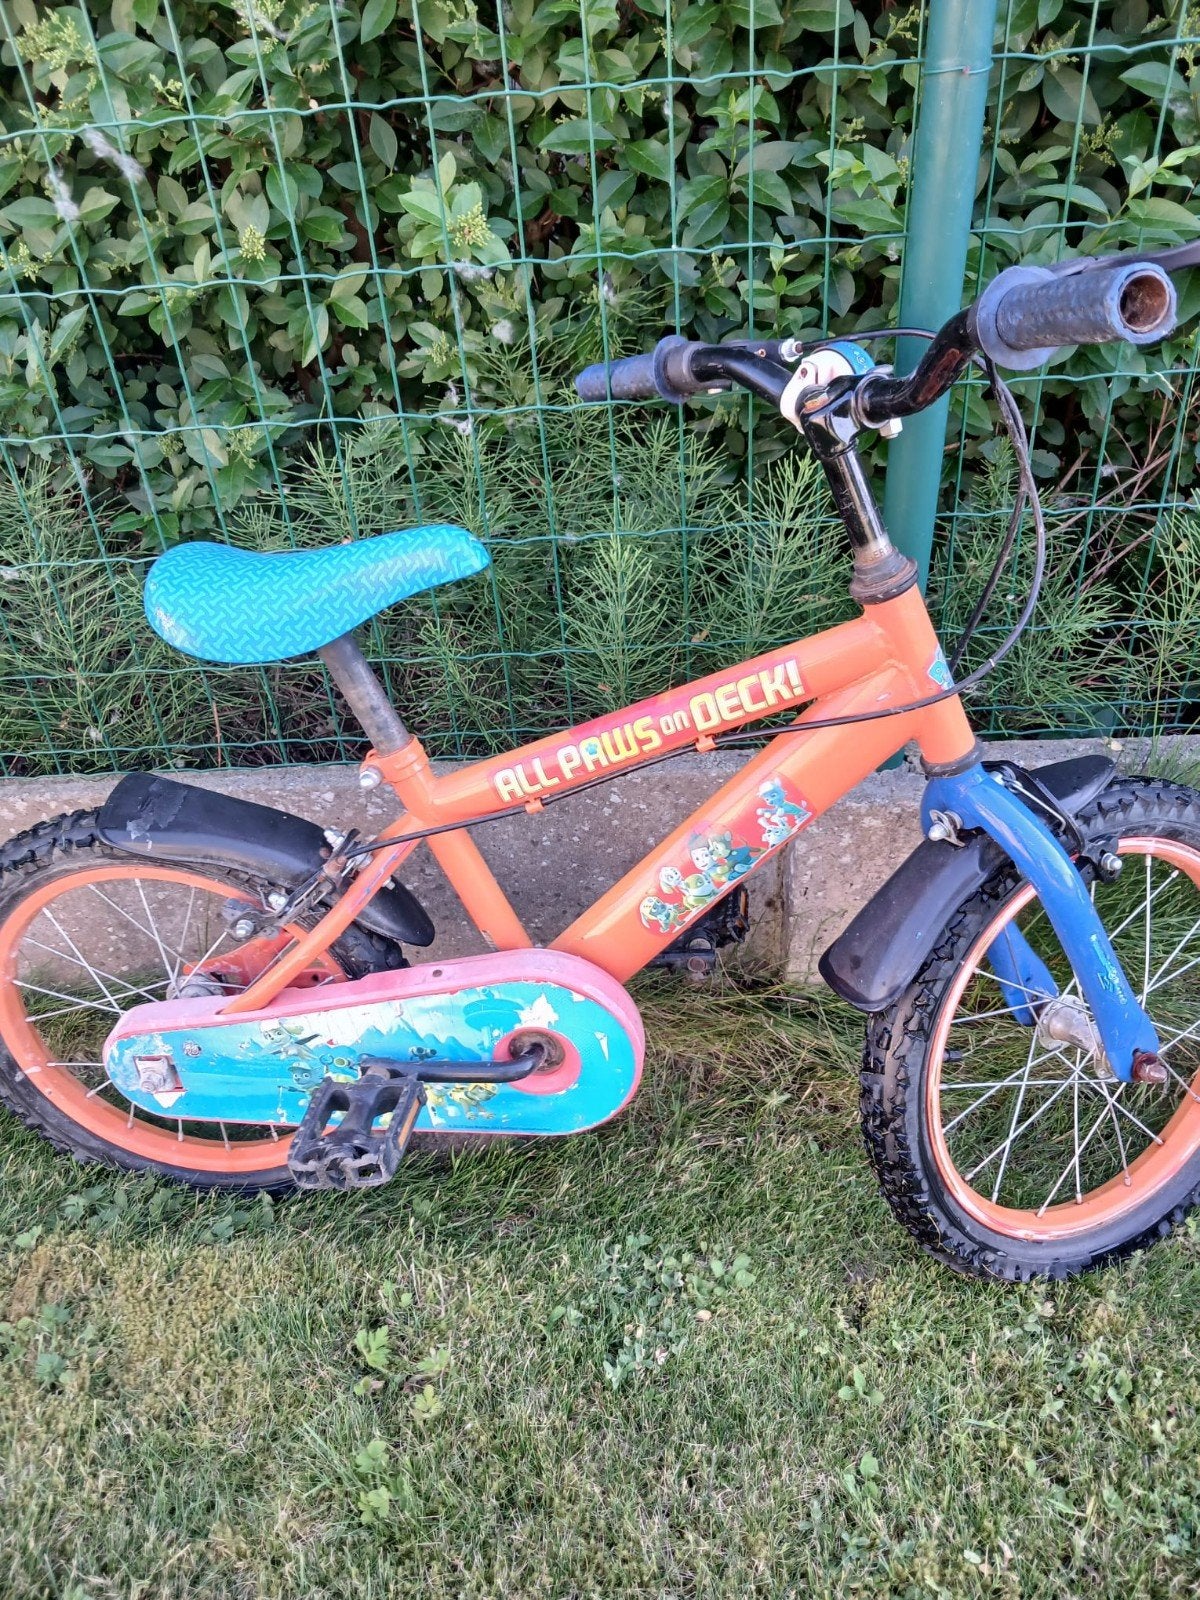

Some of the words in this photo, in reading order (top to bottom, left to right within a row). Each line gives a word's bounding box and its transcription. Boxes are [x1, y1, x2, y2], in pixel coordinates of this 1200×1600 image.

[493, 757, 560, 803] ALL
[556, 715, 662, 781] PAWS
[659, 710, 691, 737] on
[689, 659, 805, 733] DECK!
